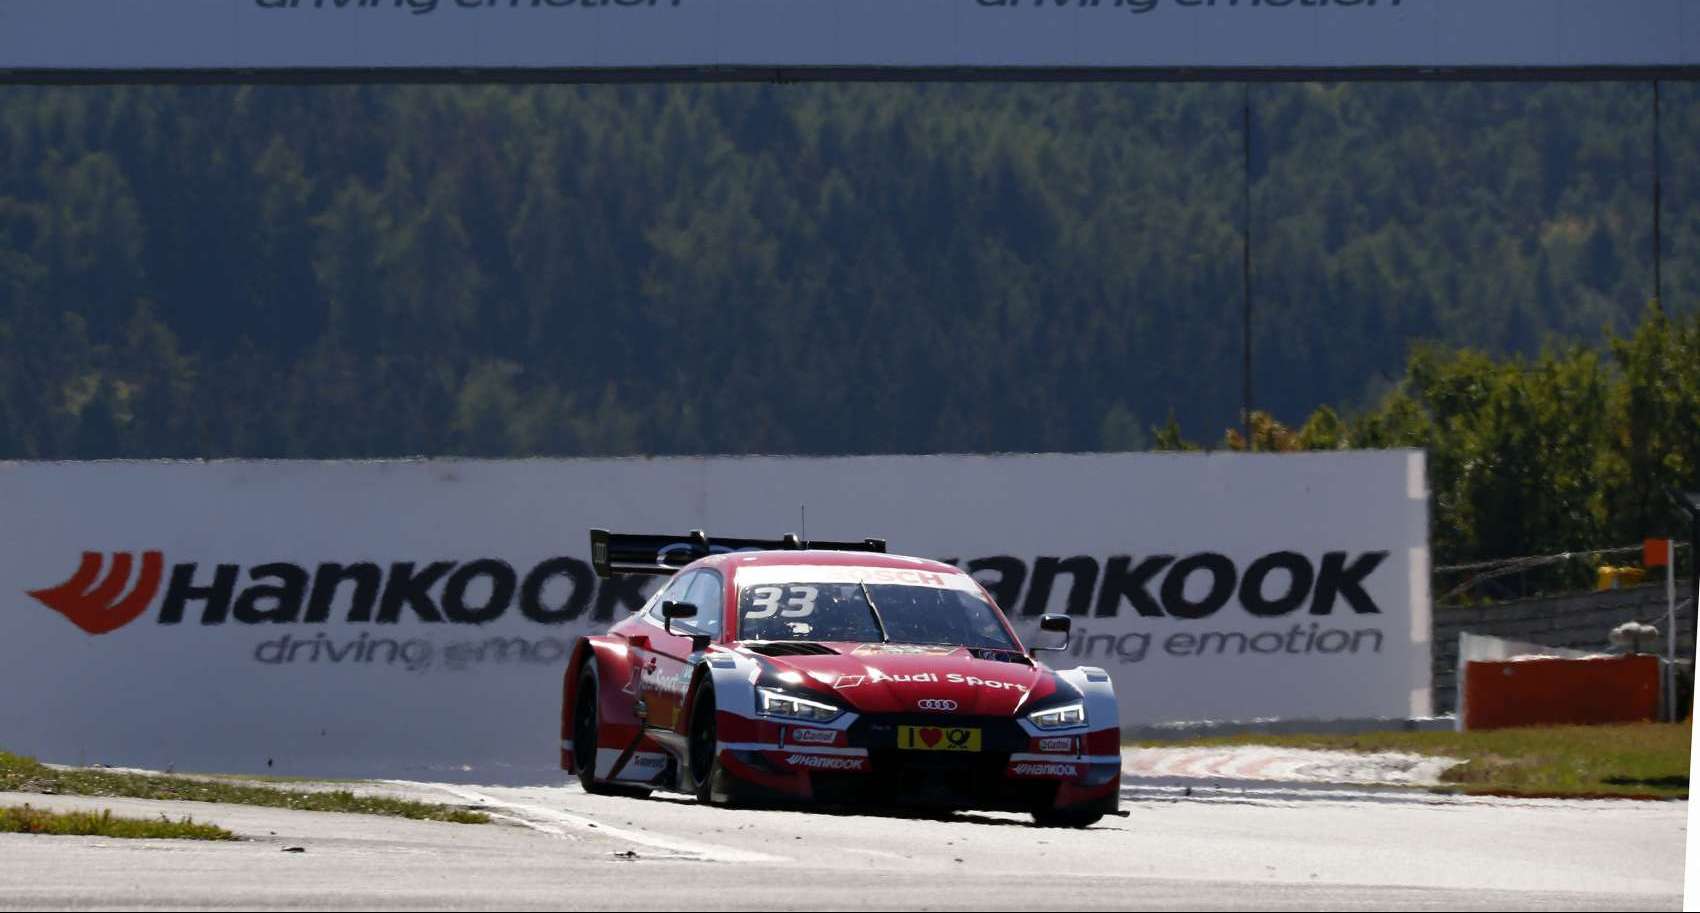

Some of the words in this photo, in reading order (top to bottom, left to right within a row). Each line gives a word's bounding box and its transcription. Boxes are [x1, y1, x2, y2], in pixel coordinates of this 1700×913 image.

[745, 585, 819, 619] 33
[952, 551, 1389, 620] anKOOK
[254, 631, 434, 671] driving
[1163, 622, 1384, 657] emotion
[870, 671, 938, 684] Audi
[945, 672, 1030, 693] Sport
